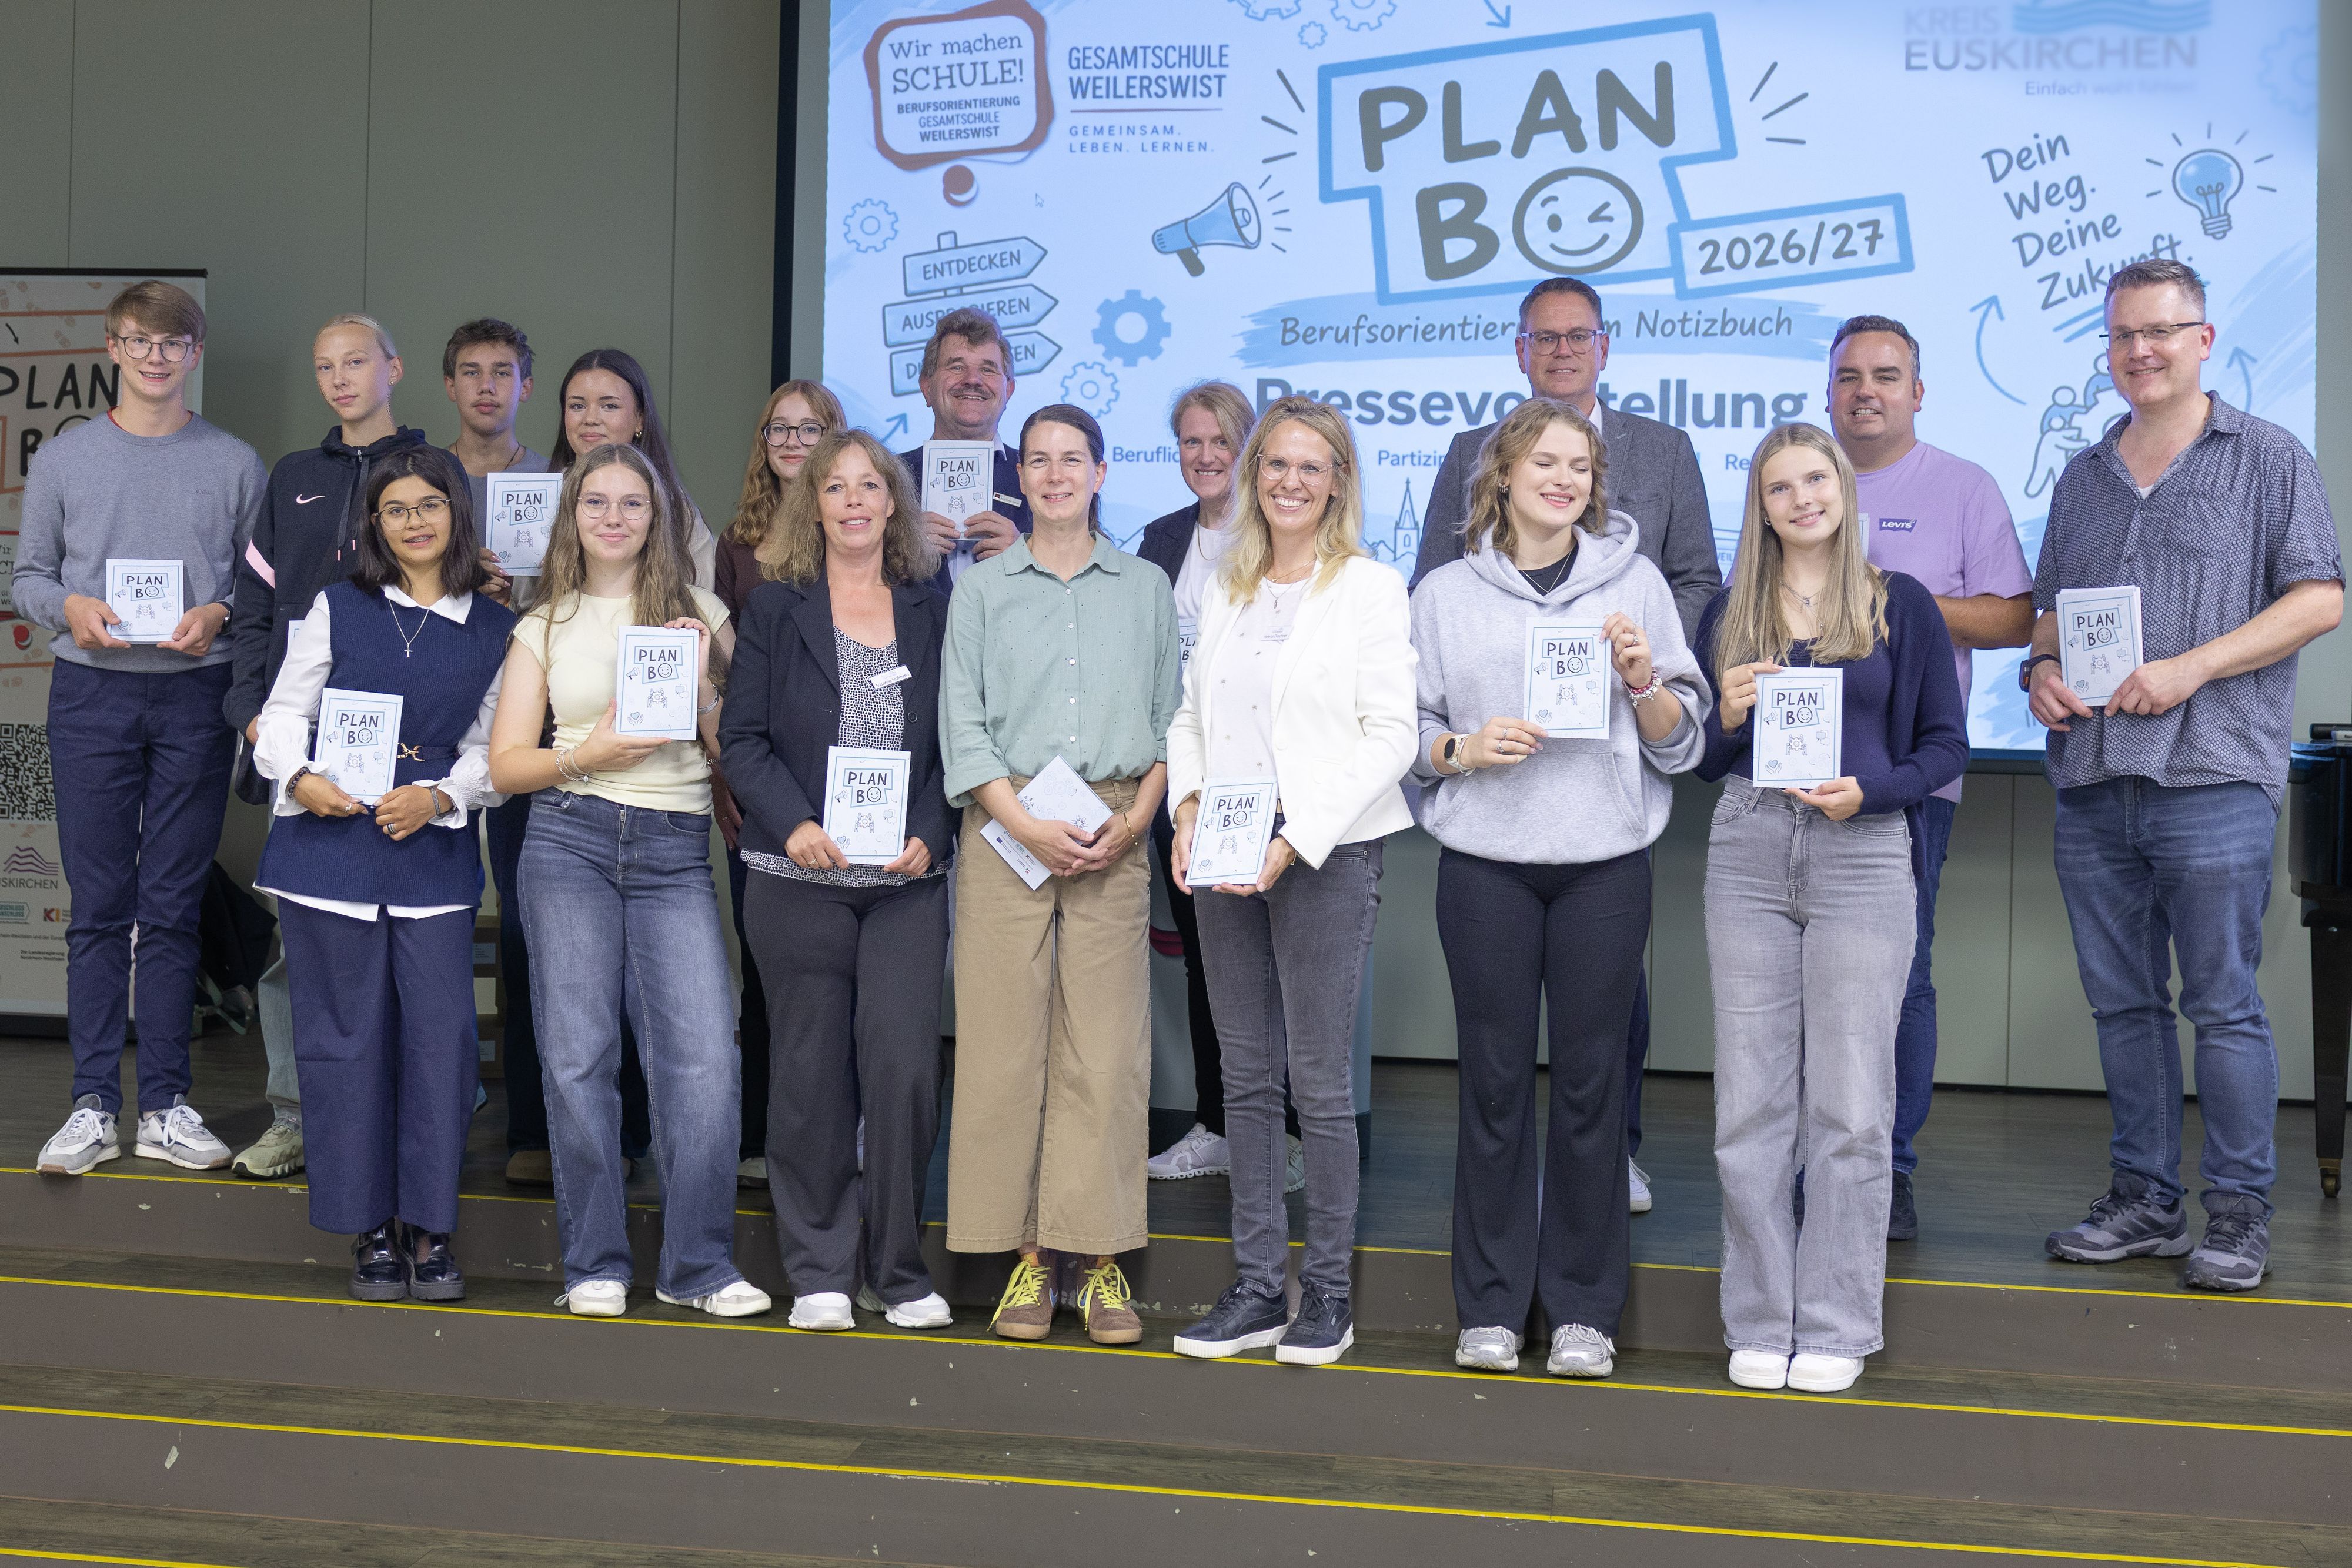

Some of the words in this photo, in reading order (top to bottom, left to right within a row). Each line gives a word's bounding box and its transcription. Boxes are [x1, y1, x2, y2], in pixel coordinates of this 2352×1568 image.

[889, 39, 932, 59] Wir
[942, 33, 1023, 55] machen
[1905, 36, 2197, 71] EUSKIRCHEN
[1068, 44, 1229, 69] GESAMTSCHULE
[893, 59, 1023, 94] SCHULE!
[1069, 74, 1227, 99] WEILERSWIST
[2025, 81, 2087, 96] Einfach
[897, 96, 1020, 115] BERUFSORIENTIERUNG
[918, 111, 1000, 128] GESAMTSCHULE
[1359, 61, 1675, 172] PLAN
[920, 126, 1000, 142] WEILERSWIST
[1069, 125, 1181, 136] GEMEINSAM.
[1070, 142, 1130, 153] LEBEN.
[1141, 141, 1215, 152] LERNEN.
[1981, 133, 2070, 183] Dein
[2004, 175, 2096, 220] Weg.
[1698, 219, 1885, 275] 2026/27
[2012, 214, 2122, 268] Deine
[923, 249, 1021, 281] ENTDECKEN
[902, 297, 1030, 332] AUSPIEREN
[1280, 314, 1519, 347] Berufsorientier
[1636, 306, 1792, 339] Notizbuch
[1112, 446, 1180, 462] Beruflic
[940, 460, 974, 472] PLAN
[506, 493, 542, 506] PLAN
[126, 576, 163, 585] PLAN
[2076, 612, 2114, 629] PLAN
[639, 648, 677, 662] PLAN
[1547, 641, 1588, 656] PLAN
[1776, 691, 1818, 706] PLAN
[340, 713, 379, 728] PLAN
[848, 771, 887, 786] PLAN
[1217, 797, 1254, 811] PLAN
[0, 877, 58, 890] SKIRCHEN
